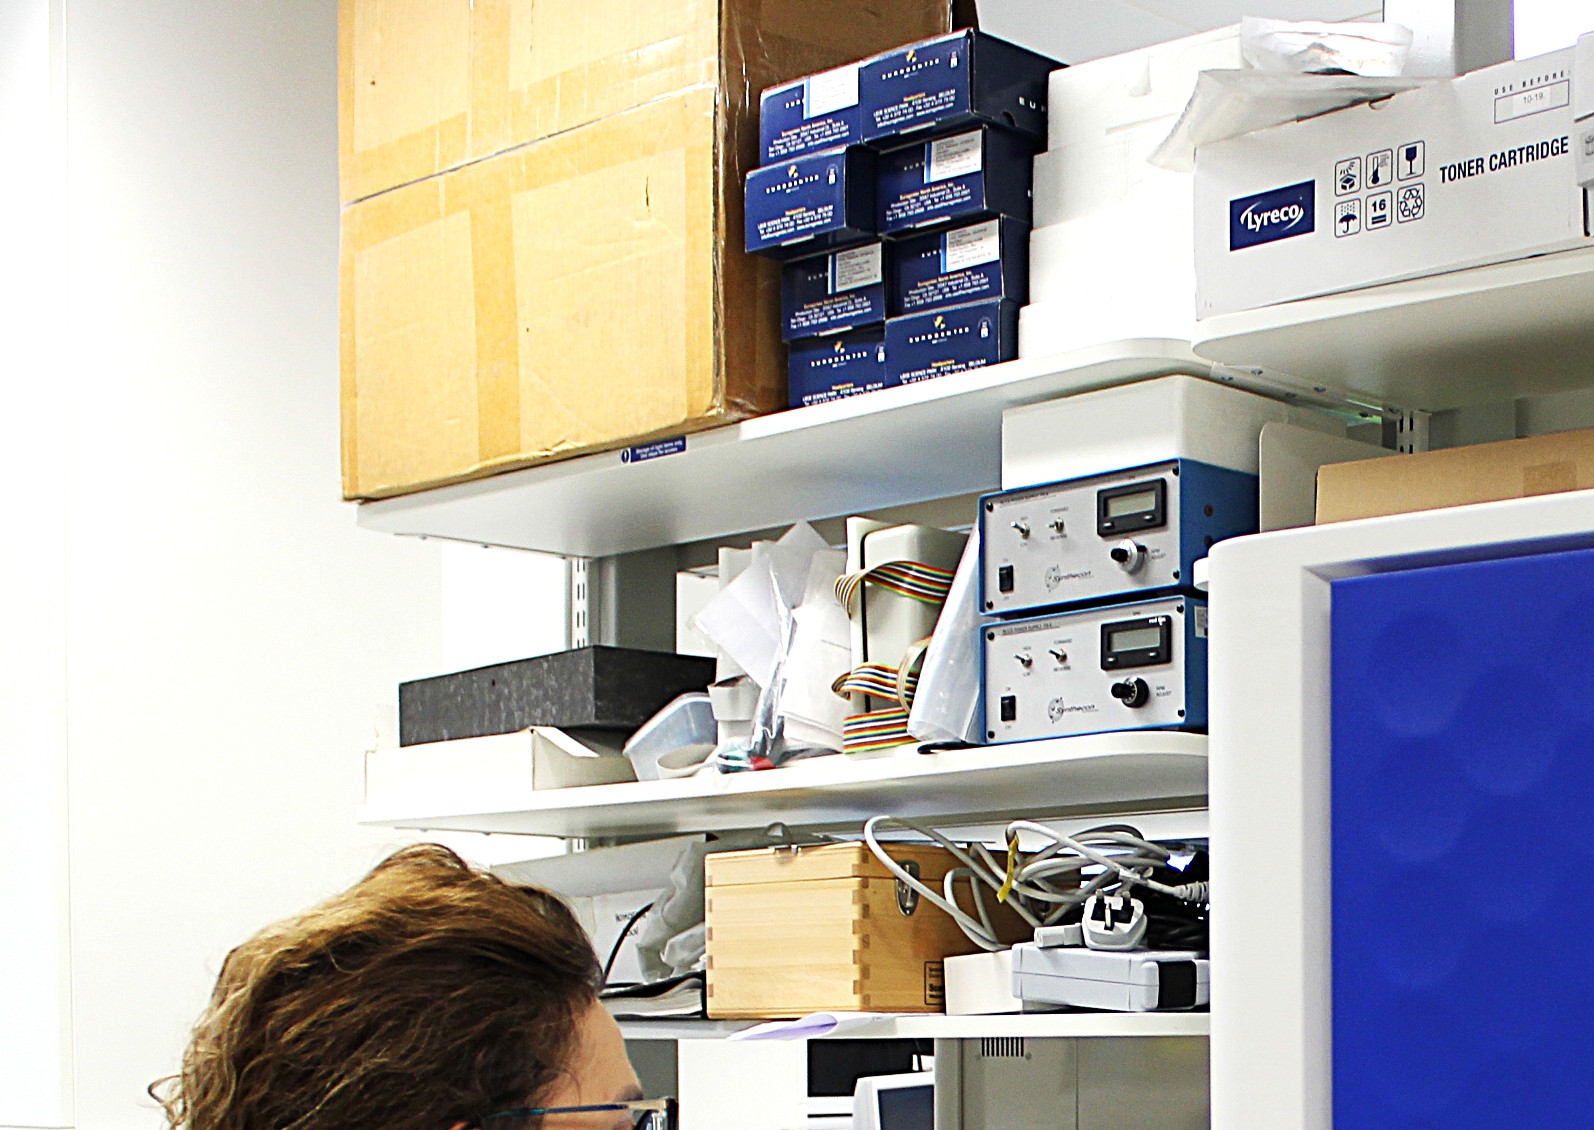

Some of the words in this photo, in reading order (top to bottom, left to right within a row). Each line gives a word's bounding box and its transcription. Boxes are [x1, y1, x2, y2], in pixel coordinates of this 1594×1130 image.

[1494, 84, 1513, 96] USE
[1440, 161, 1485, 184] TONER
[1489, 136, 1570, 173] CARTRIDGE
[1245, 205, 1300, 233] Lyreco
